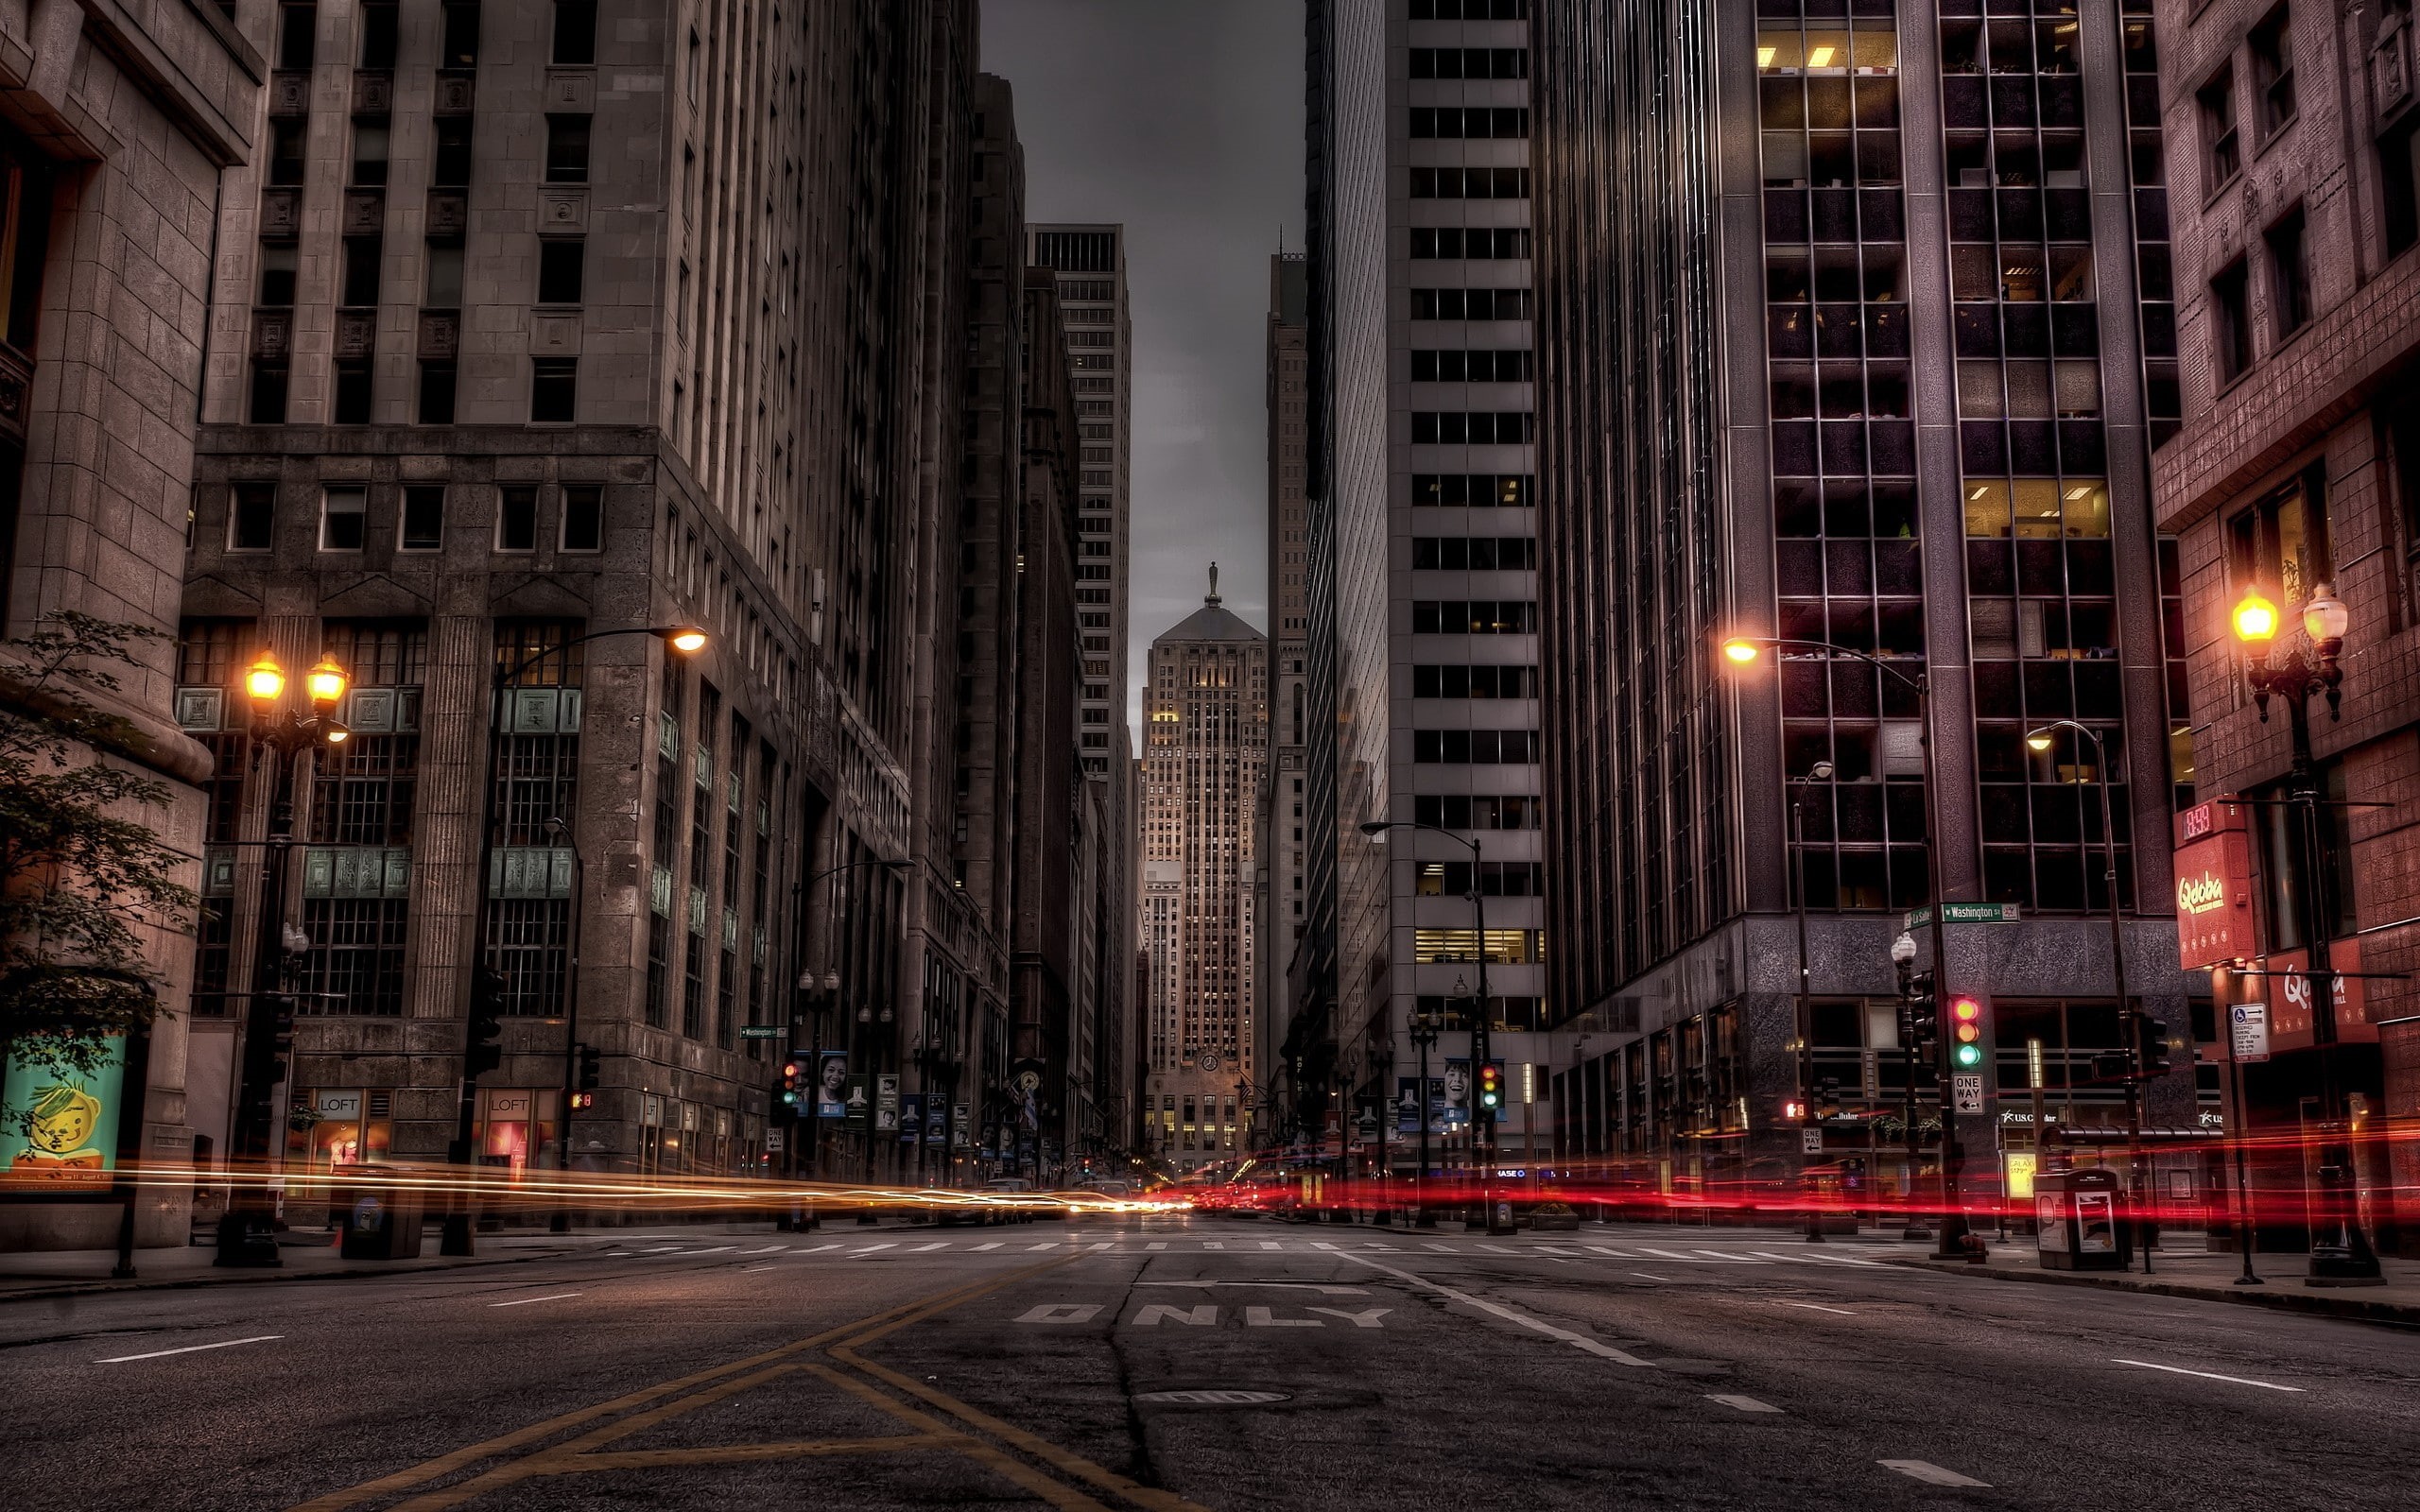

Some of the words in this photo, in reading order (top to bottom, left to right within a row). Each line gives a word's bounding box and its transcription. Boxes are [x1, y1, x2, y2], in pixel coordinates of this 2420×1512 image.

[2178, 870, 2223, 915] Qdoba
[1951, 906, 1993, 920] Washington
[1956, 1077, 1979, 1088] ONE
[1956, 1089, 1980, 1098] WAY
[320, 1098, 358, 1111] LOFT
[491, 1098, 528, 1111] LOFT
[1012, 1304, 1394, 1329] ONLY
